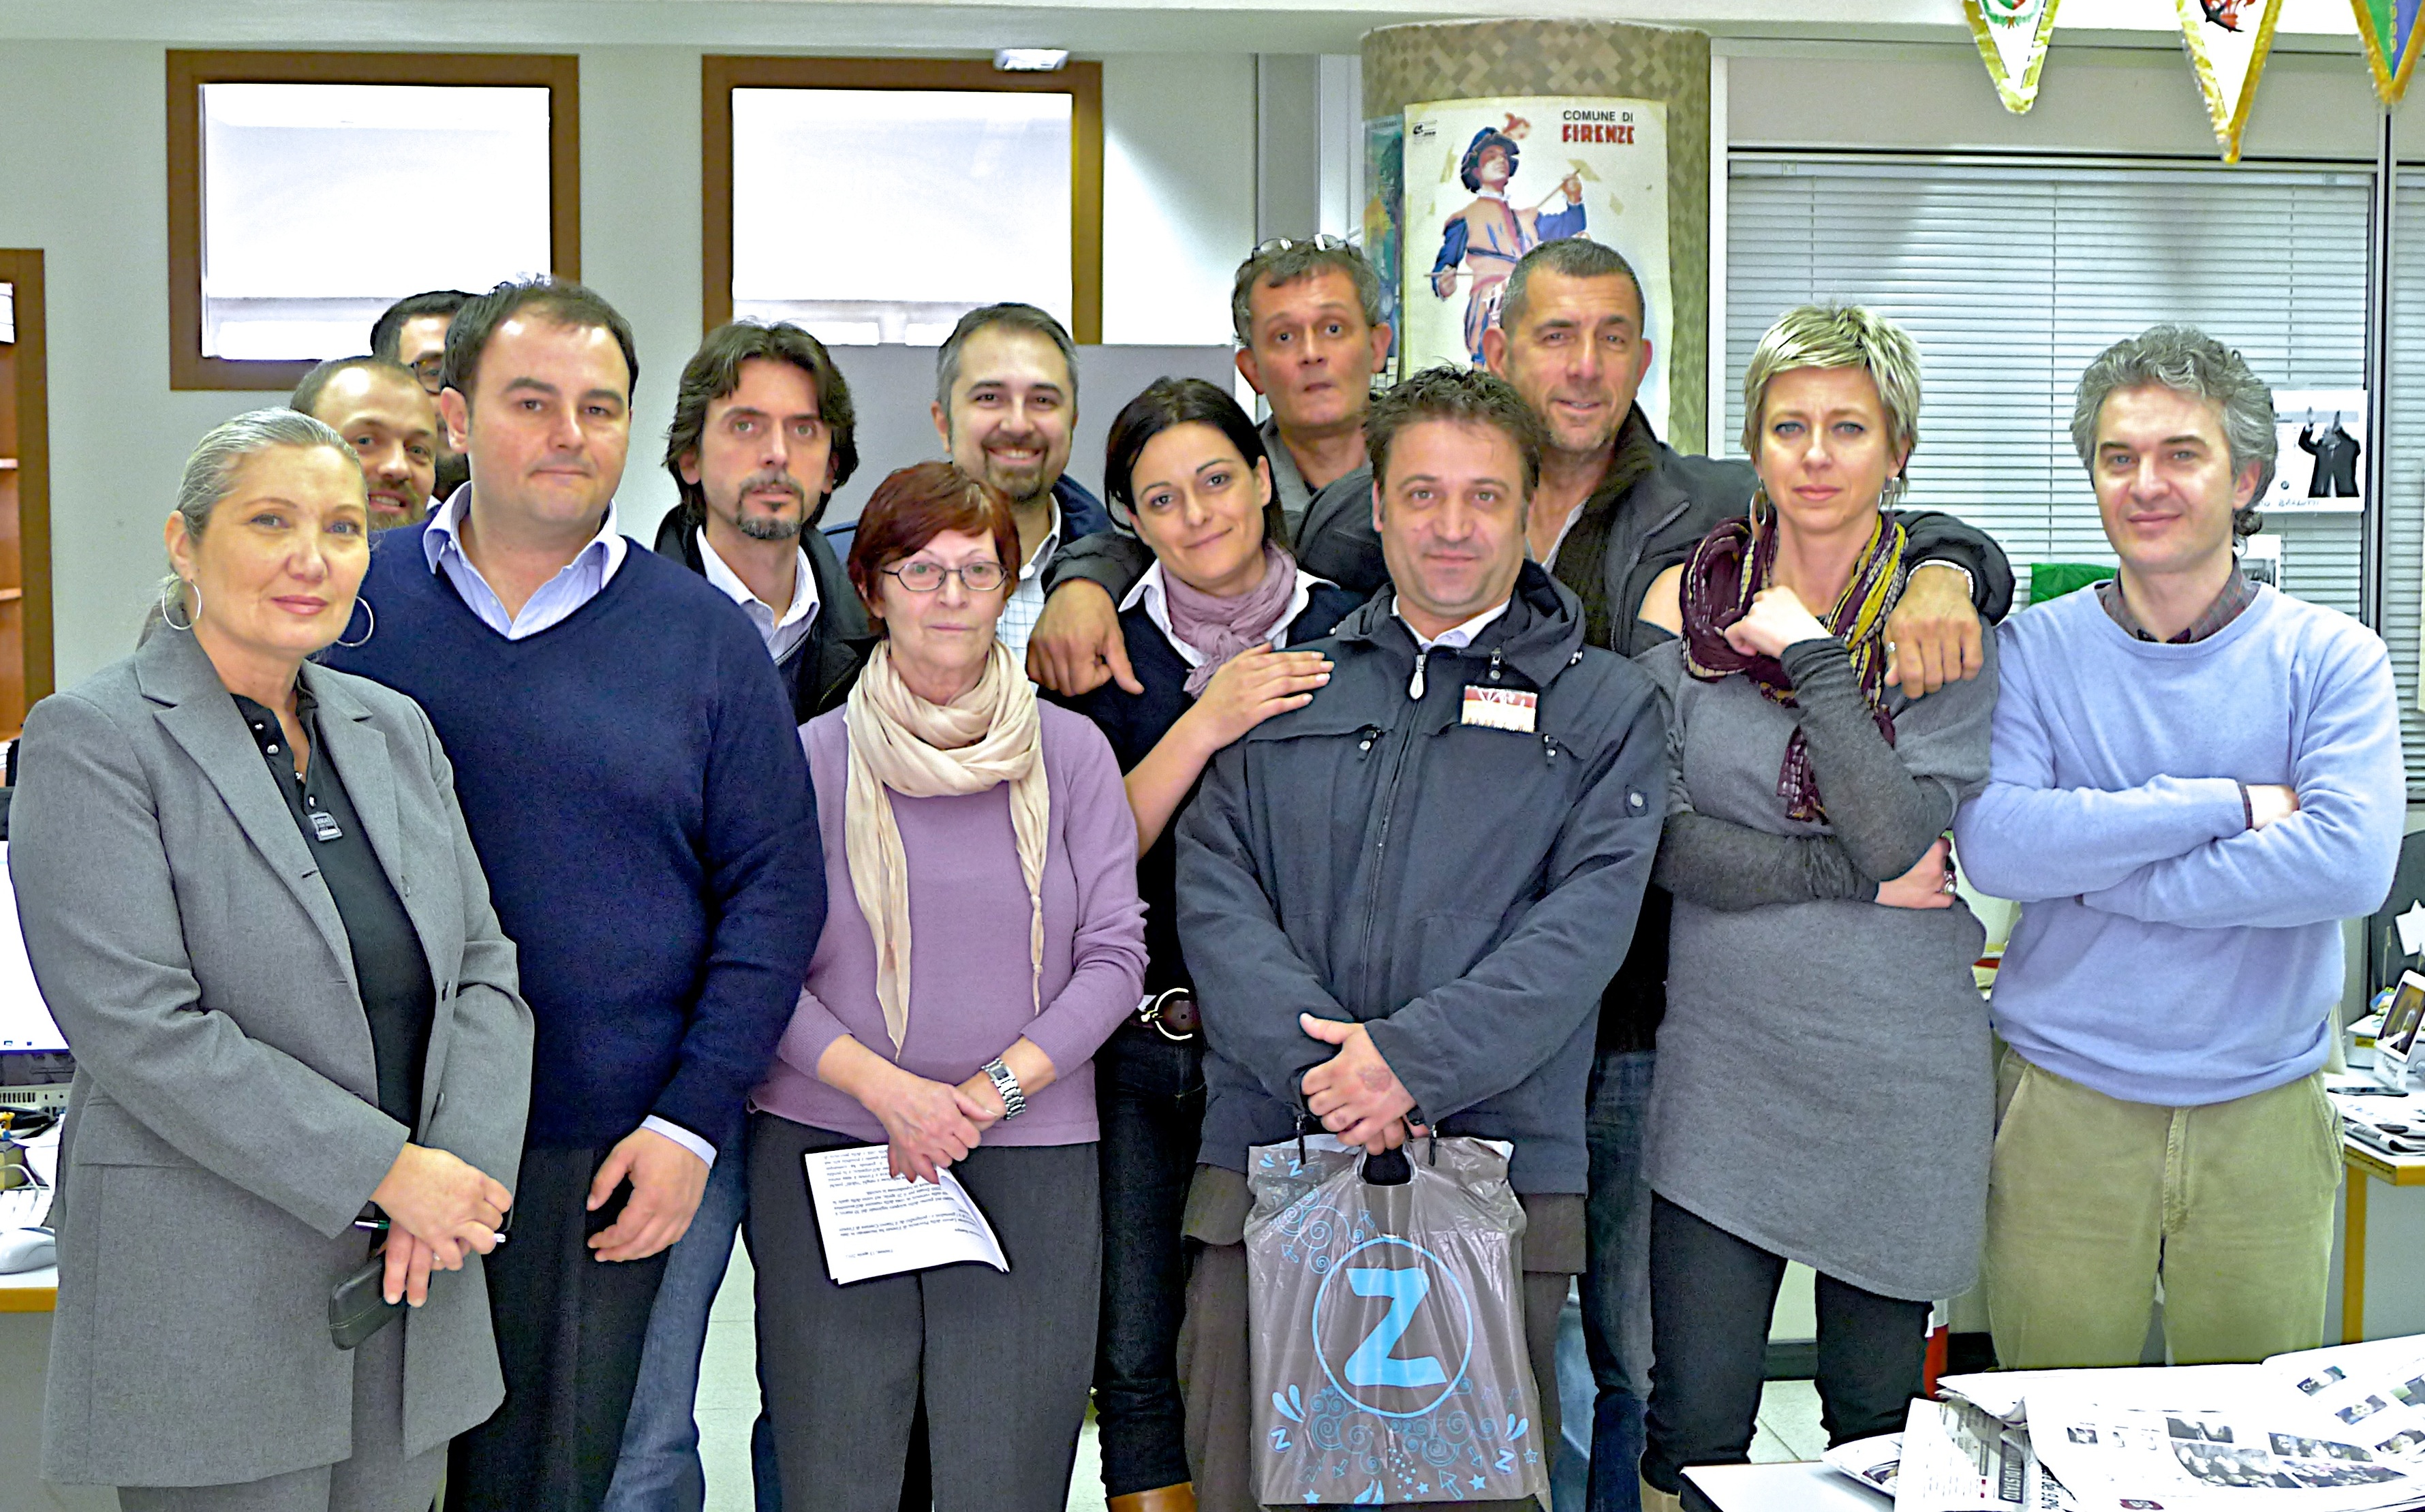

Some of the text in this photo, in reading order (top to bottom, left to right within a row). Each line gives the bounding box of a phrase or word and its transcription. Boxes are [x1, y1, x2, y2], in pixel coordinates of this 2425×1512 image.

[1563, 110, 1633, 122] COMUNE DI
[1562, 123, 1635, 144] FIRENZE
[1287, 1158, 1303, 1177] Z
[1344, 1267, 1447, 1387] Z
[1271, 1429, 1291, 1450] Z
[1495, 1449, 1515, 1473] Z
[2003, 1478, 2021, 1500] STATO
